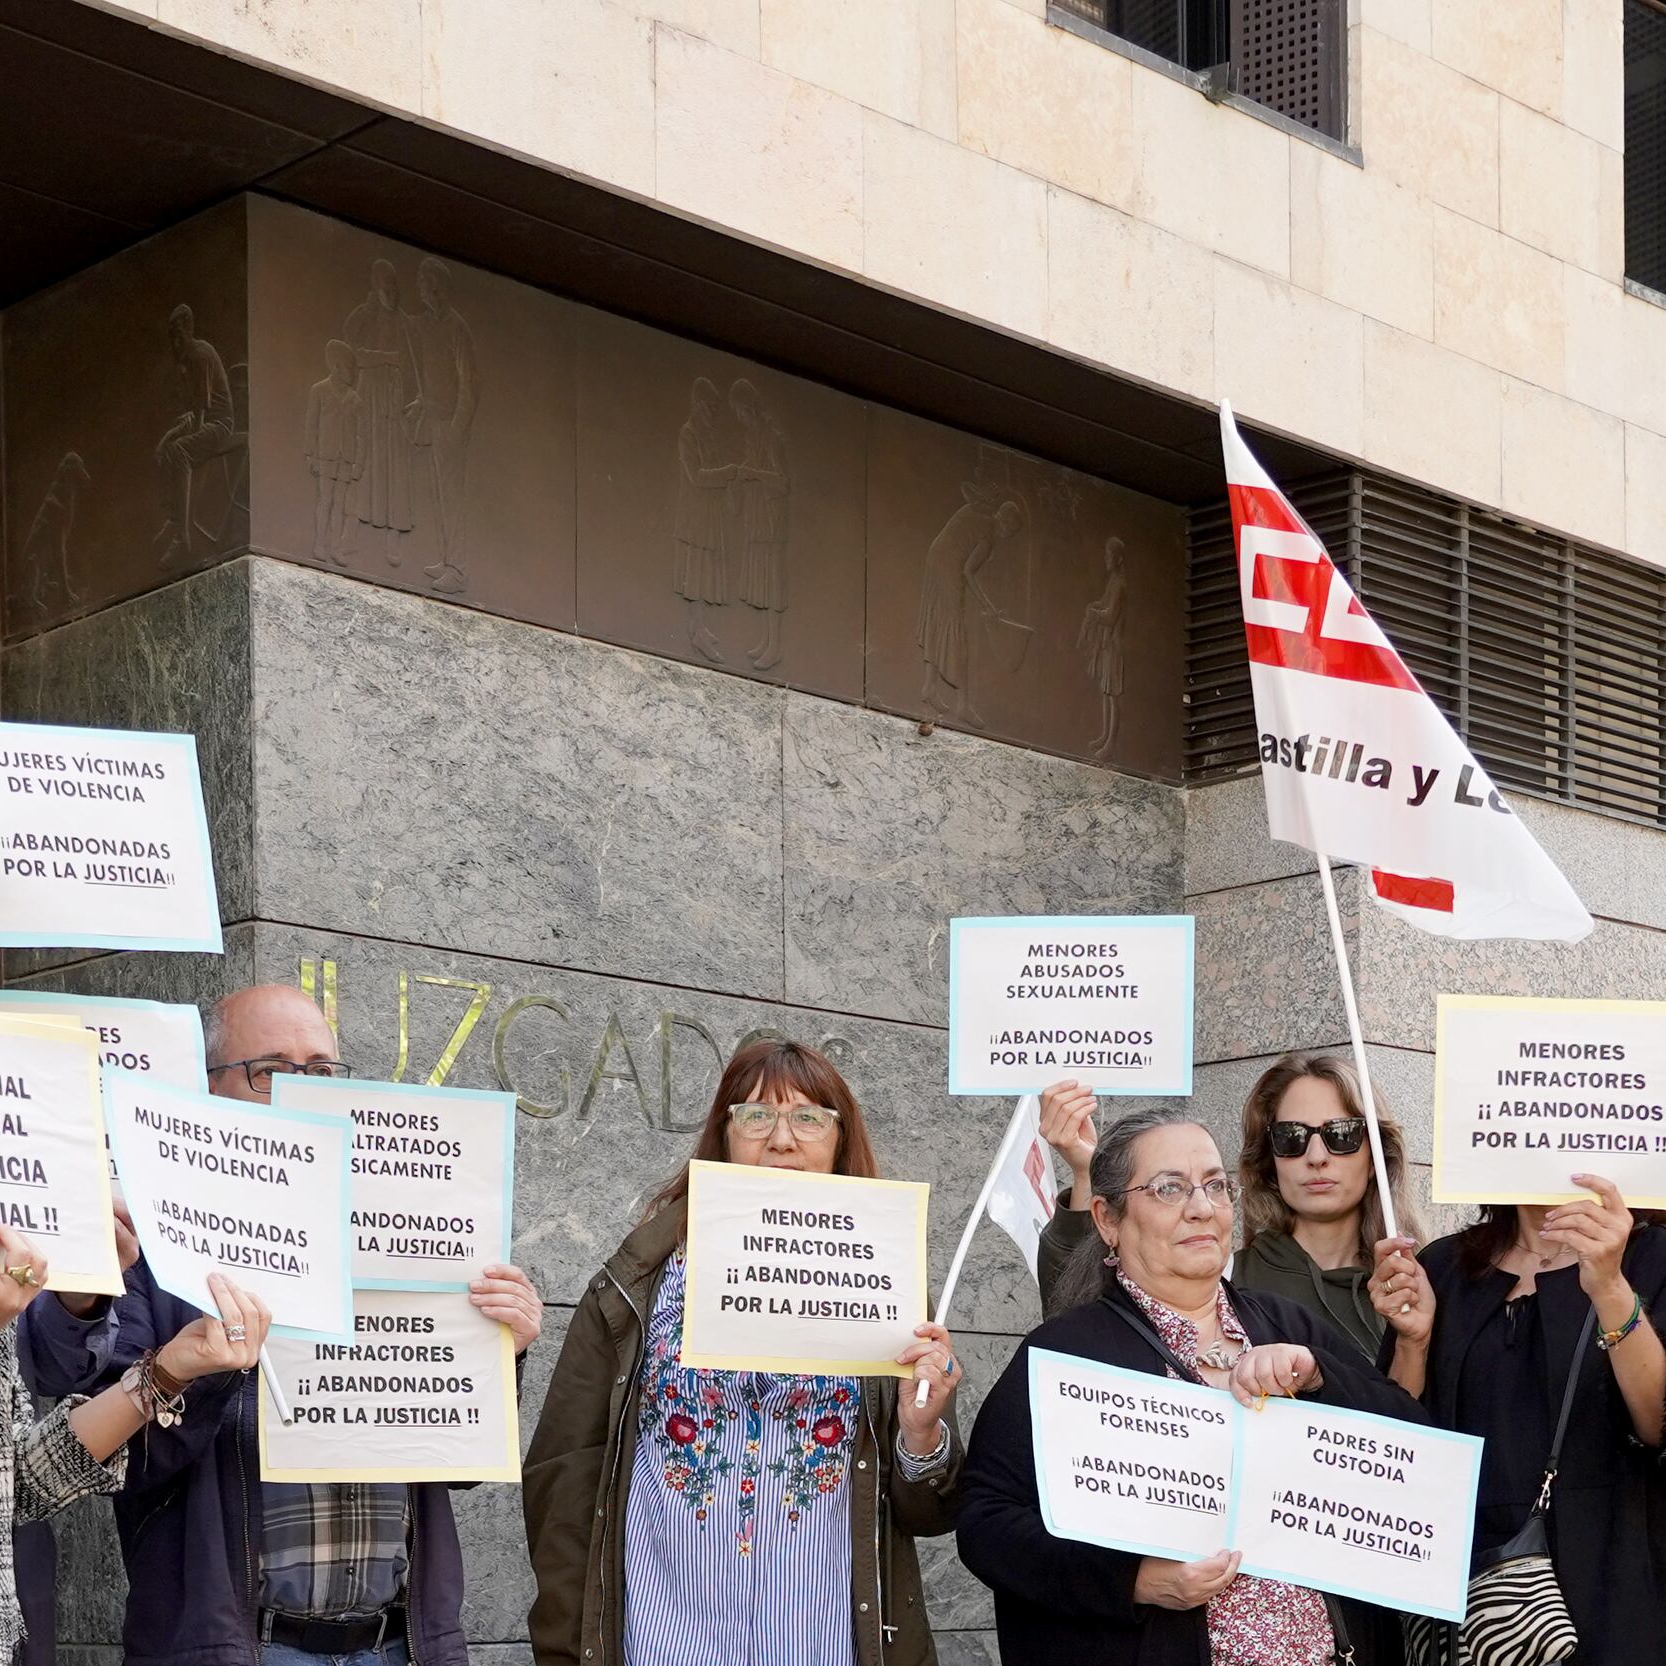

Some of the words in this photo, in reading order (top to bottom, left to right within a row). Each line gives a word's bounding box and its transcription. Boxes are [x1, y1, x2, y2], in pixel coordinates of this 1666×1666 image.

[72, 752, 165, 779] VÍCTIMAS
[1260, 733, 1393, 790] astilla
[1406, 764, 1440, 807] y
[7, 777, 33, 793] DE
[38, 779, 145, 803] VIOLENCIA
[4, 858, 47, 877] POR
[53, 861, 77, 879] LA
[1028, 944, 1118, 957] MENORES
[1020, 964, 1124, 978] ABUSADOS
[1007, 985, 1138, 999] SEXUALMENTE
[300, 957, 854, 1134] UZGAD
[1520, 1042, 1625, 1060] MENORES
[991, 1051, 1028, 1065] POR
[1036, 1051, 1057, 1064] LA
[1498, 1070, 1646, 1090] INFRACTORES
[350, 1109, 439, 1132] MENORES
[1498, 1101, 1663, 1121] ABANDONADOS
[135, 1106, 212, 1144] MUJERES
[219, 1127, 314, 1163] VÍCTIMAS
[352, 1134, 461, 1157] LTRATADOS
[1472, 1131, 1517, 1148] POR
[1525, 1132, 1551, 1148] LA
[1557, 1133, 1648, 1151] JUSTICIA
[159, 1141, 179, 1162] DE
[185, 1148, 289, 1186] VIOLENCIA
[351, 1158, 451, 1180] SICAMENTE
[350, 1211, 474, 1234] ANDONADOS
[762, 1208, 854, 1231] MENORES
[158, 1221, 188, 1248] POR
[192, 1235, 212, 1256] LA
[358, 1236, 380, 1252] LA
[743, 1235, 874, 1260] INFRACTORES
[745, 1266, 892, 1290] ABANDONADOS
[721, 1295, 762, 1313] POR
[769, 1298, 792, 1315] LA
[798, 1300, 880, 1319] JUSTICIA
[354, 1315, 434, 1333] ENORES
[315, 1344, 454, 1362] INFRACTORES
[317, 1375, 473, 1393] ABANDONADOS
[1059, 1382, 1135, 1410] EQUIPOS
[1141, 1396, 1225, 1424] TÉCNICOS
[293, 1407, 336, 1424] POR
[343, 1407, 368, 1424] LA
[374, 1408, 461, 1424] JUSTICIA
[1100, 1412, 1189, 1438] FORENSES
[1307, 1426, 1377, 1454] PADRES
[1384, 1444, 1414, 1463] SIN
[1313, 1449, 1405, 1483] CUSTODIA
[1075, 1475, 1111, 1494] POR
[1118, 1482, 1139, 1498] LA
[1271, 1509, 1308, 1532] POR
[1315, 1520, 1336, 1538] LA
